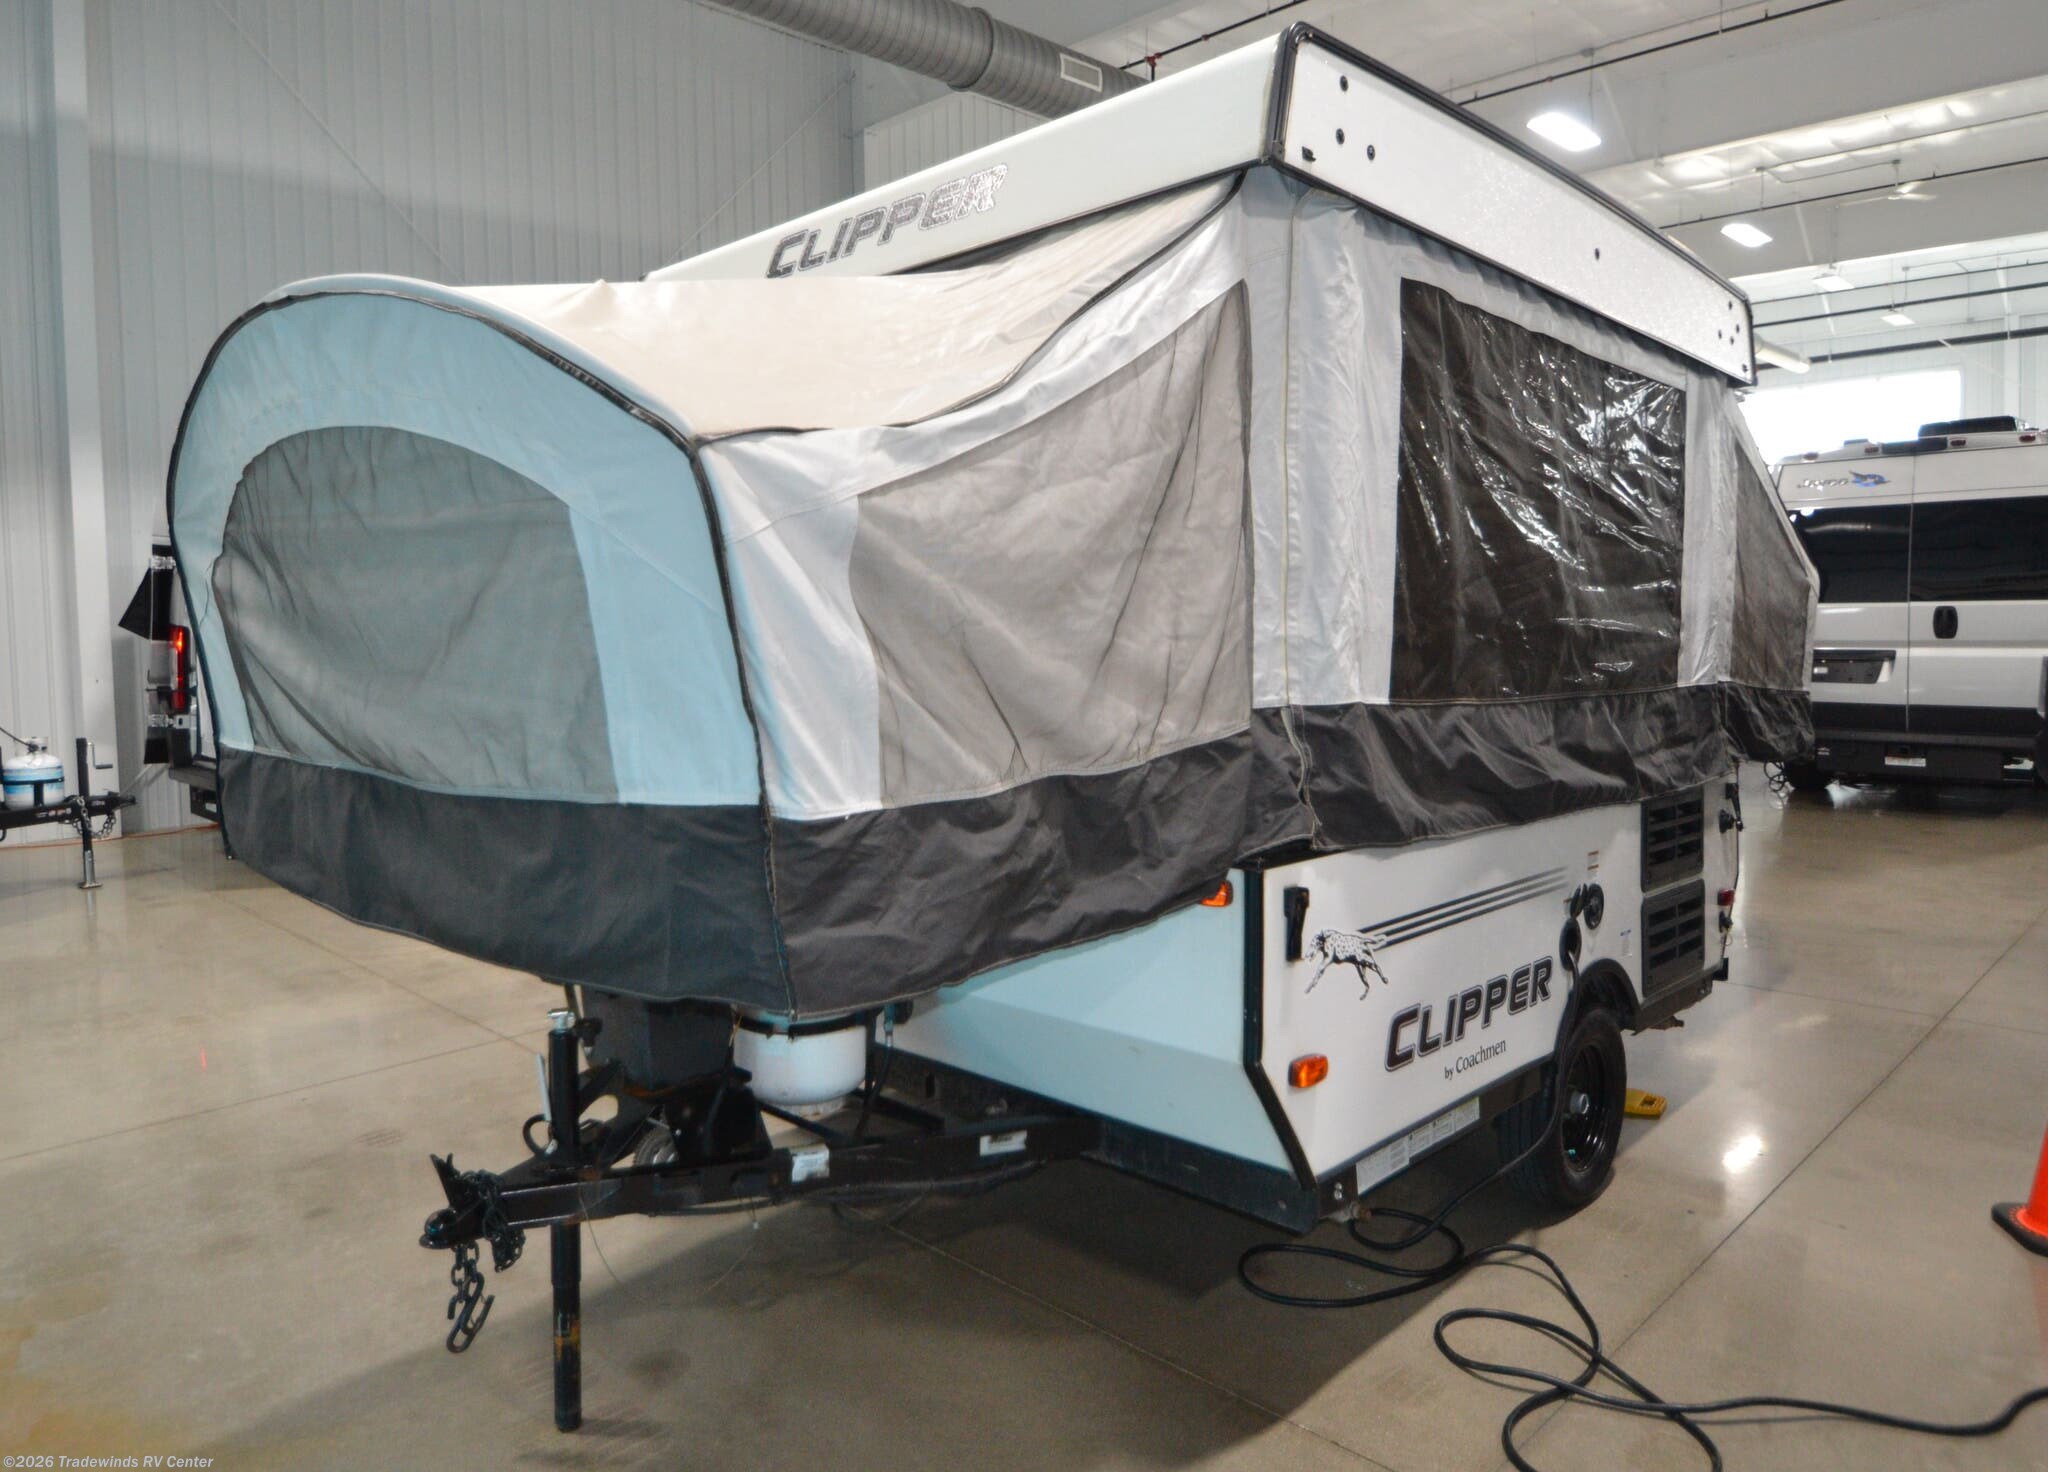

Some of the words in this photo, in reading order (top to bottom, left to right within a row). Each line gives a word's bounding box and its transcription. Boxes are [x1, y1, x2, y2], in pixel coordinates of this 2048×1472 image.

[765, 163, 1008, 279] CLIPPER
[1384, 955, 1553, 1072] CLIPPER
[1444, 1066, 1455, 1080] by
[1456, 1040, 1506, 1073] Coachmen
